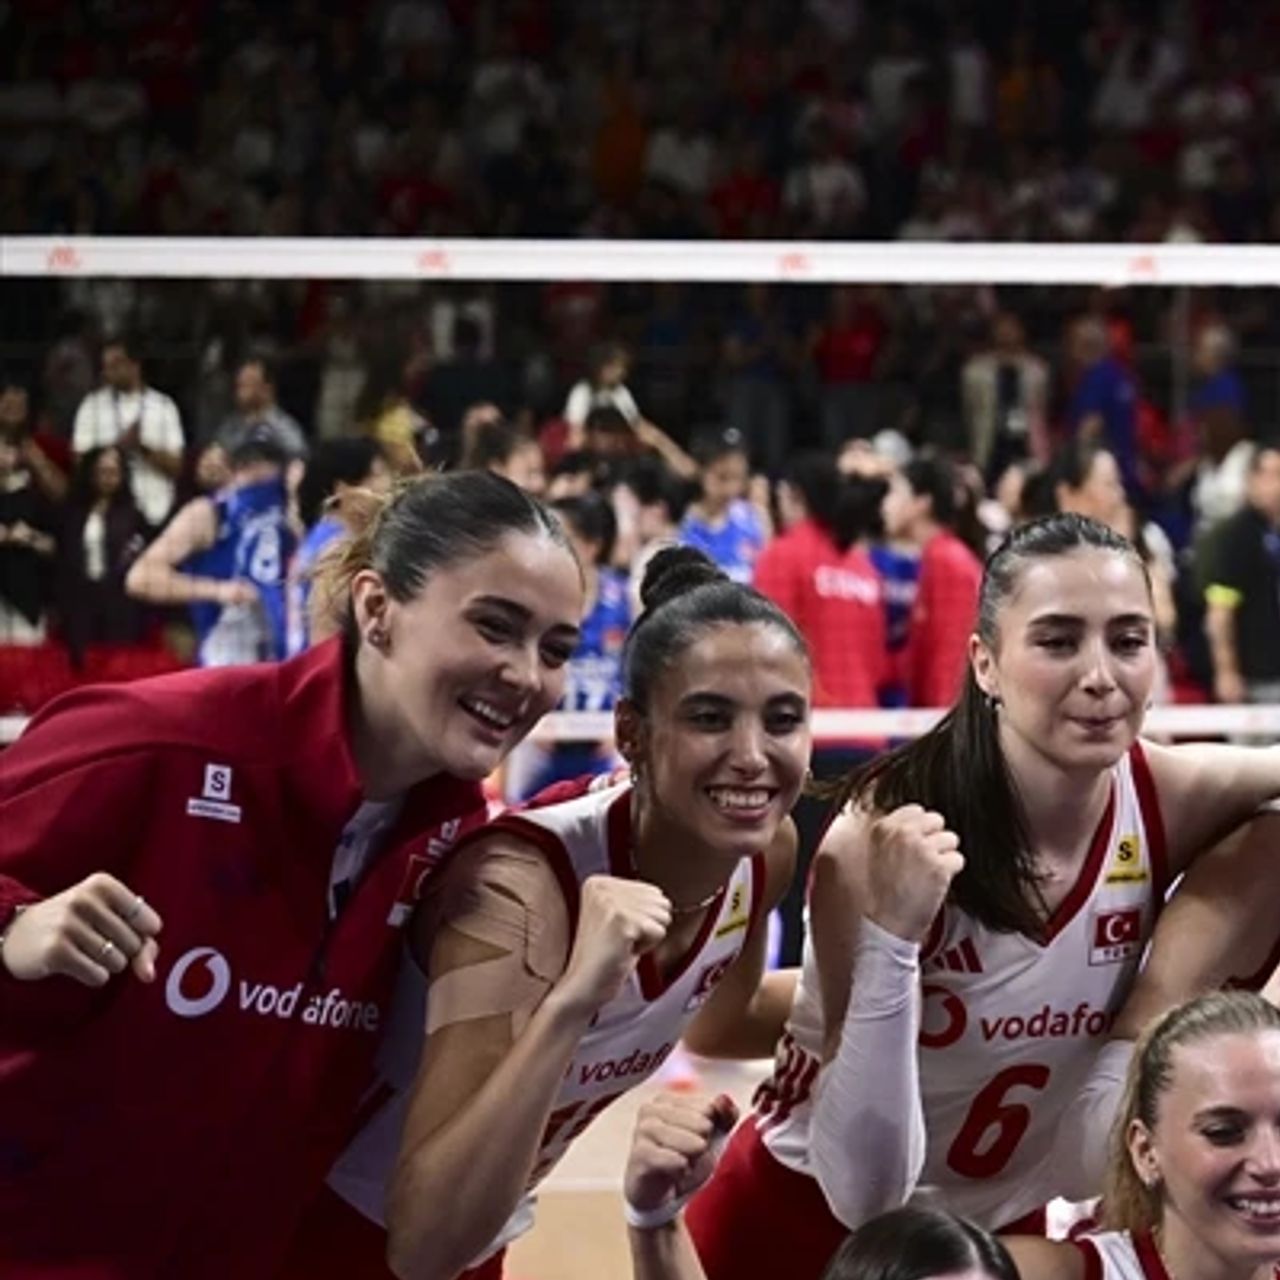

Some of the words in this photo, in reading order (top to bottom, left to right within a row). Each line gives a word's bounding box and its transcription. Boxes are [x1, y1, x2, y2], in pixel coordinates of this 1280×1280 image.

[210, 770, 226, 793] S
[1118, 842, 1133, 863] S
[946, 1063, 1051, 1180] 6
